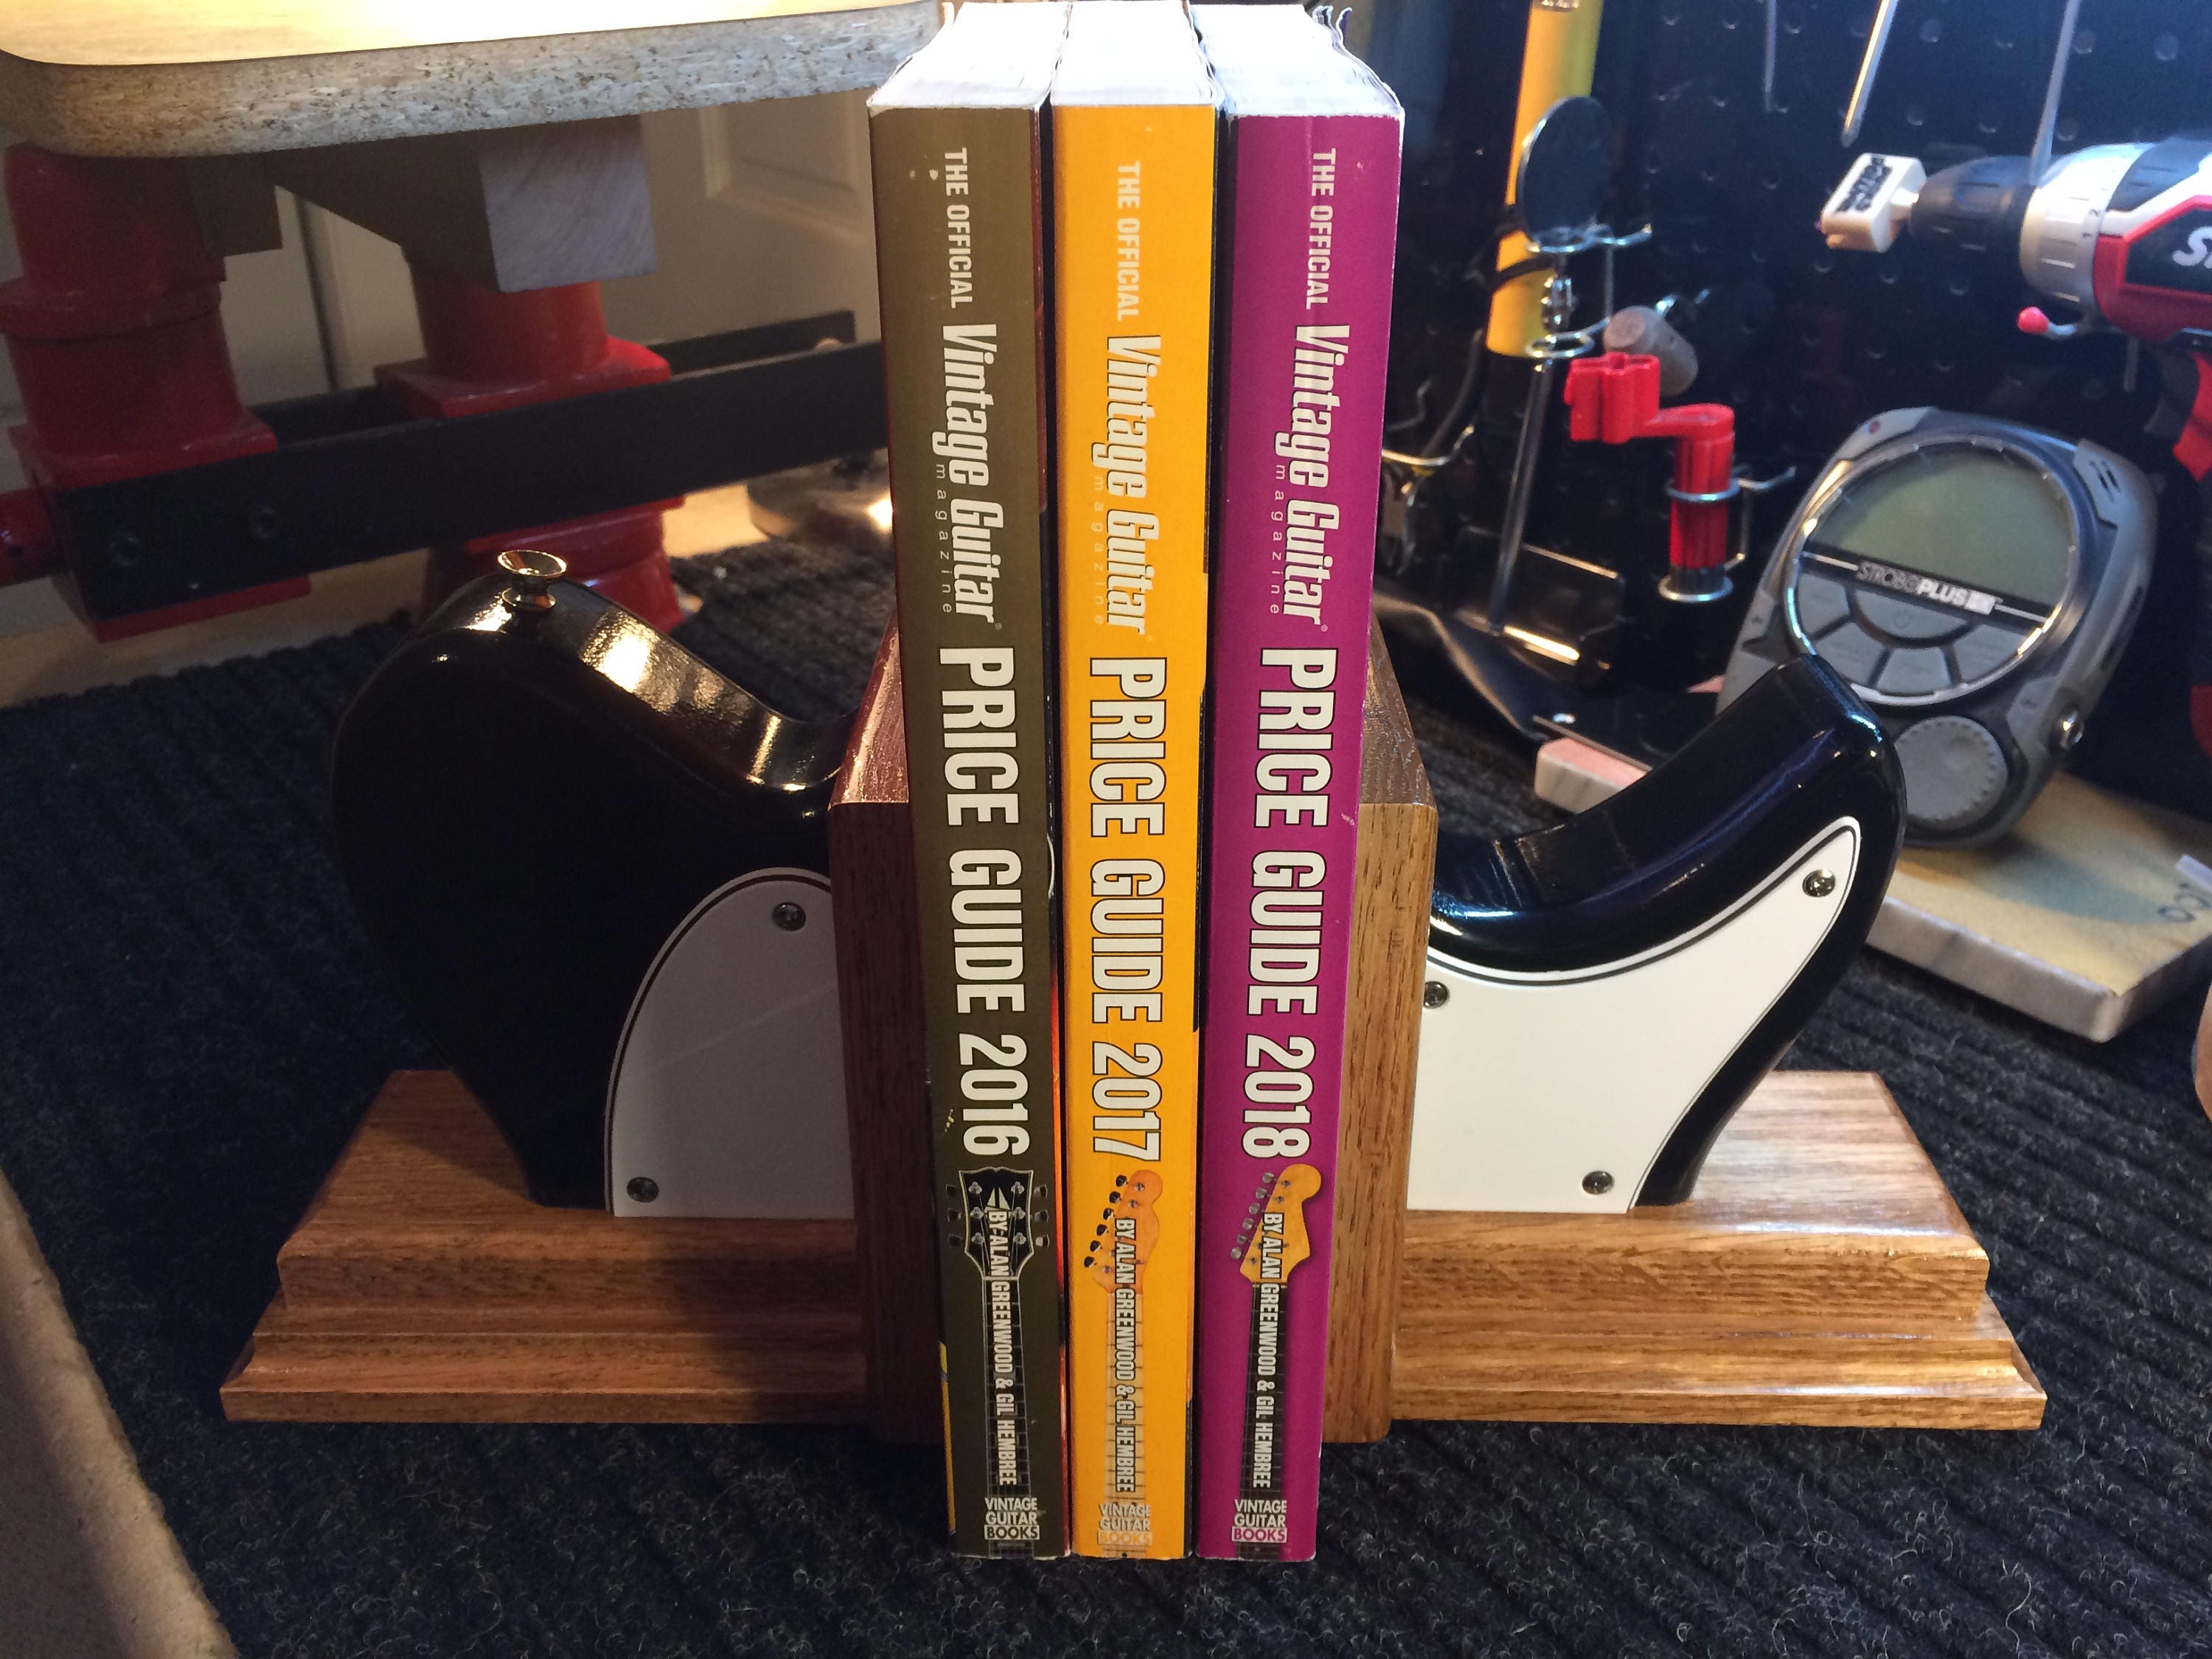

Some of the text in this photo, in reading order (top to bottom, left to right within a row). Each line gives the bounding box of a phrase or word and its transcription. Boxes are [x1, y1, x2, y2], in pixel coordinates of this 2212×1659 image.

[945, 147, 973, 308] THE OFFICIAL
[1116, 161, 1141, 322] THE OFFICIAL
[1306, 147, 1336, 310] THE OFFICIAL
[2172, 226, 2212, 270] S
[932, 324, 1004, 623] Vintage Guitar
[1091, 335, 1161, 635] Vintage Guitar
[1274, 324, 1350, 625] Vintage Guitar
[935, 464, 952, 613] magazine
[1091, 475, 1105, 625] magazine
[1270, 465, 1286, 614] magazine
[939, 646, 1030, 1156] PRICE GUIDE 2016
[1089, 656, 1167, 1162] PRICE GUIDE 2017
[1241, 647, 1338, 1159] PRICE GUIDE 2018
[991, 1281, 1013, 1373] GREENWOOD
[995, 1377, 1014, 1389] &
[1115, 1218, 1136, 1492] BY ALAN GREENWOOD & GIL HEMBREE
[1253, 1212, 1284, 1488] BY ALAN GREENWOOD & GIL HEMBREE
[995, 1393, 1015, 1416] GIL
[997, 1419, 1017, 1486] HEMBREE
[984, 1497, 1037, 1511] VINTAGE
[985, 1511, 1038, 1525] GUITAR
[987, 1526, 1038, 1538] BOOKS
[1099, 1503, 1151, 1517] VINTAGE
[1099, 1517, 1150, 1531] GUITAR
[1099, 1532, 1151, 1543] BOOKS
[1234, 1499, 1287, 1514] VINTAGE
[1234, 1514, 1286, 1528] GUITAR
[1234, 1528, 1285, 1541] BOOKS
